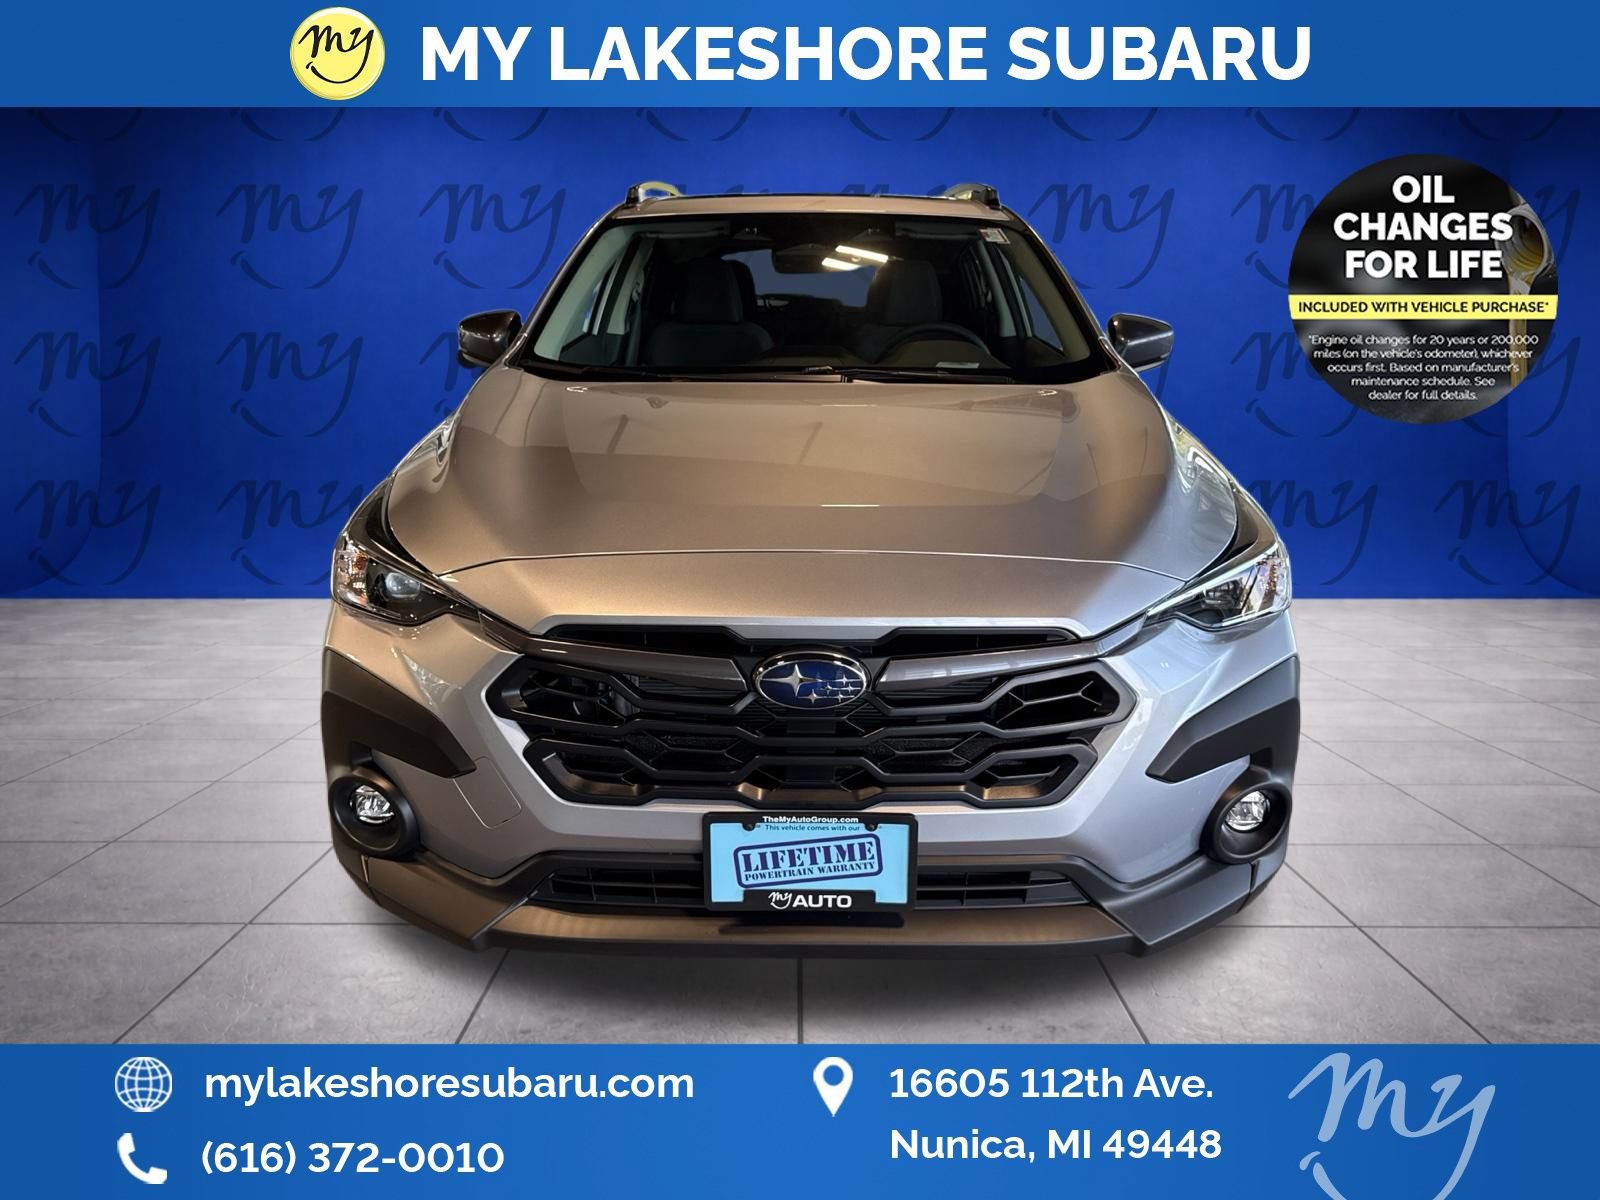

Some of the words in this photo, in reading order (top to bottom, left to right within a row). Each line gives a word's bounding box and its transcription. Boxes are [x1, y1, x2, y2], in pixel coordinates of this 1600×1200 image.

[762, 816, 860, 824] TheMyAutoGroup.com
[830, 824, 847, 832] with
[742, 841, 875, 872] LIFETIME
[744, 867, 814, 881] POWERTRAIN
[817, 861, 876, 874] WARRANTY
[792, 894, 852, 909] AUTO
